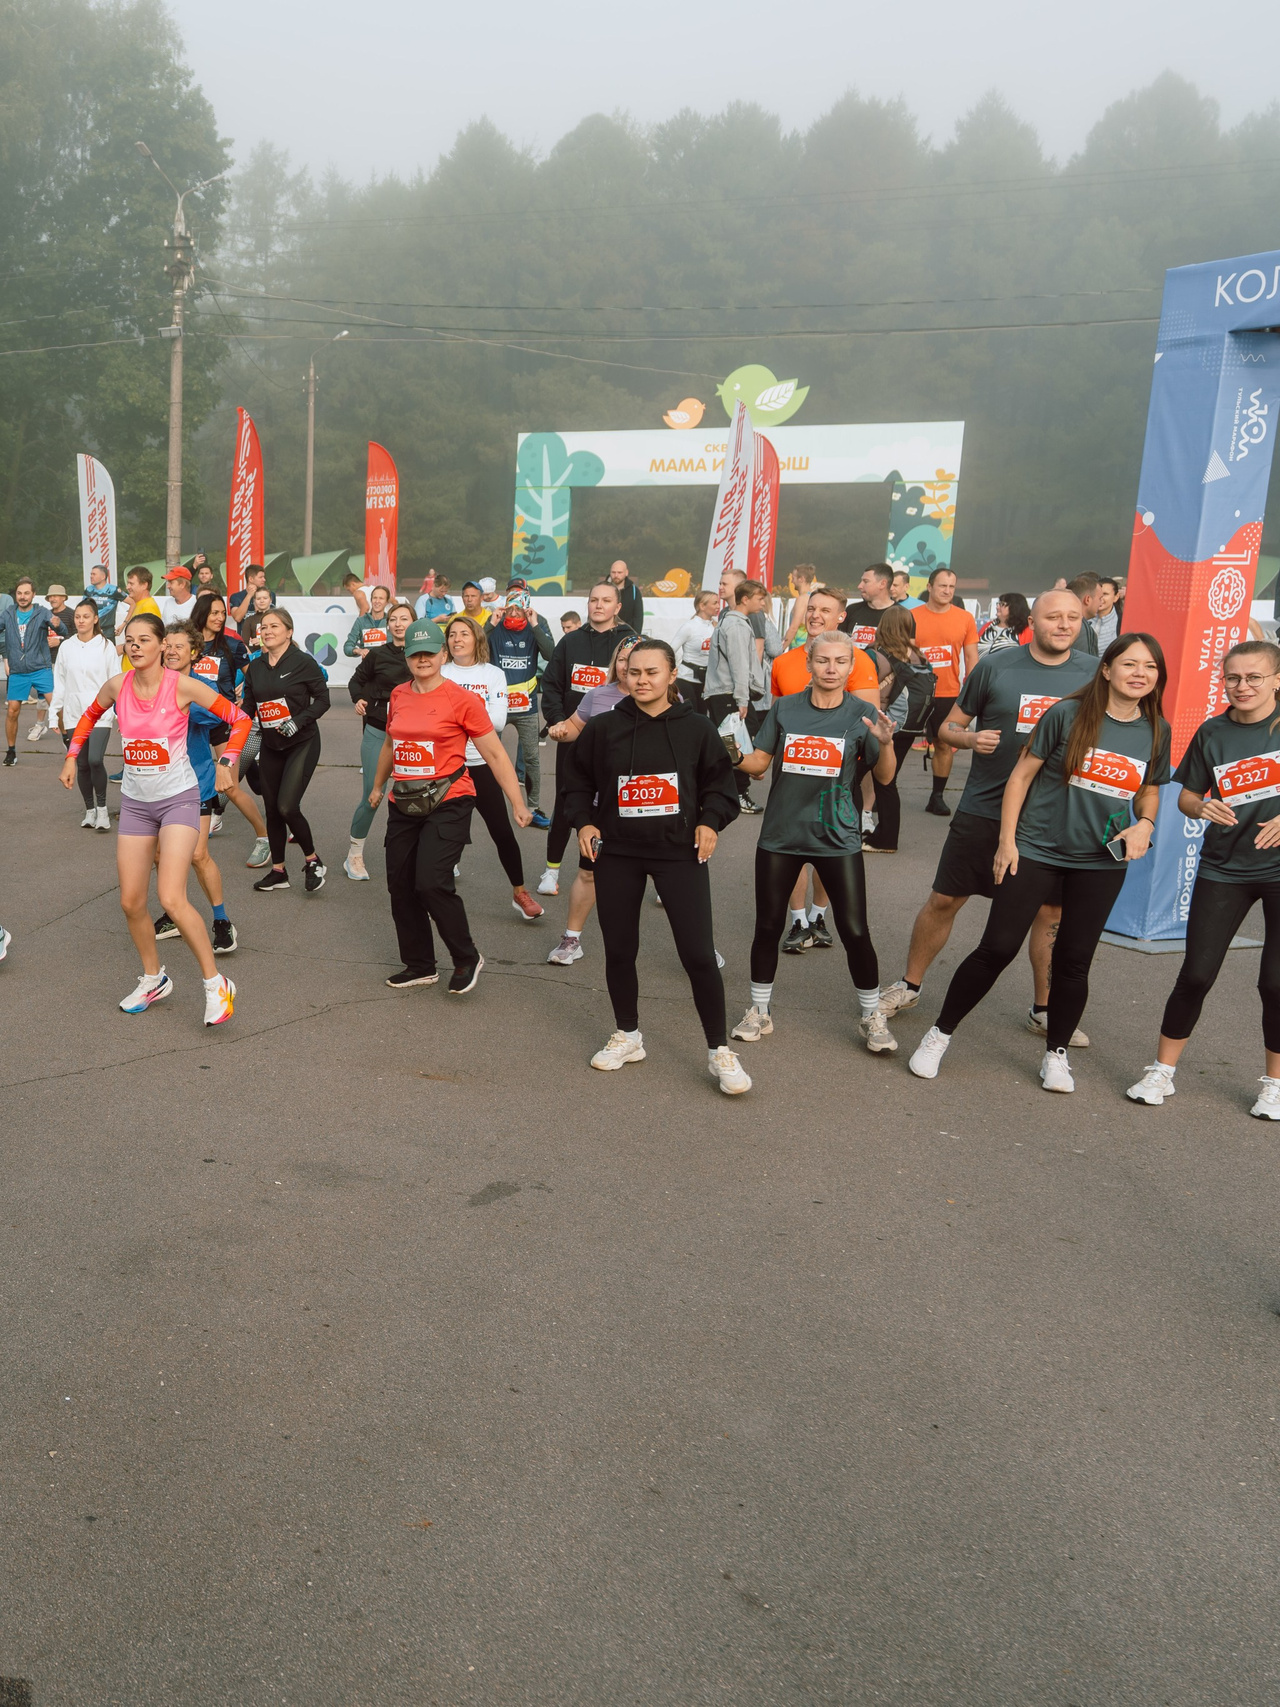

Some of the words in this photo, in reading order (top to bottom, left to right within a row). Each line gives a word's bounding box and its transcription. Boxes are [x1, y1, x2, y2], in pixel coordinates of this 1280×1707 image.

[704, 443, 728, 453] СКВ
[1228, 426, 1238, 462] МАРАФОН
[649, 458, 707, 472] МАМА
[1198, 626, 1214, 672] ТУЛА
[928, 652, 944, 660] 2121
[194, 662, 211, 671] 2210
[580, 674, 601, 684] 2013
[1204, 626, 1227, 723] ПОЛУМАРА
[262, 707, 281, 718] 2206
[130, 749, 159, 761] 2008
[400, 750, 422, 762] 2180
[797, 747, 829, 760] 2330
[1092, 763, 1128, 781] 2329
[1234, 767, 1269, 787] 2327
[632, 787, 664, 800] 2037
[1180, 843, 1197, 921] ЭВОКОМ
